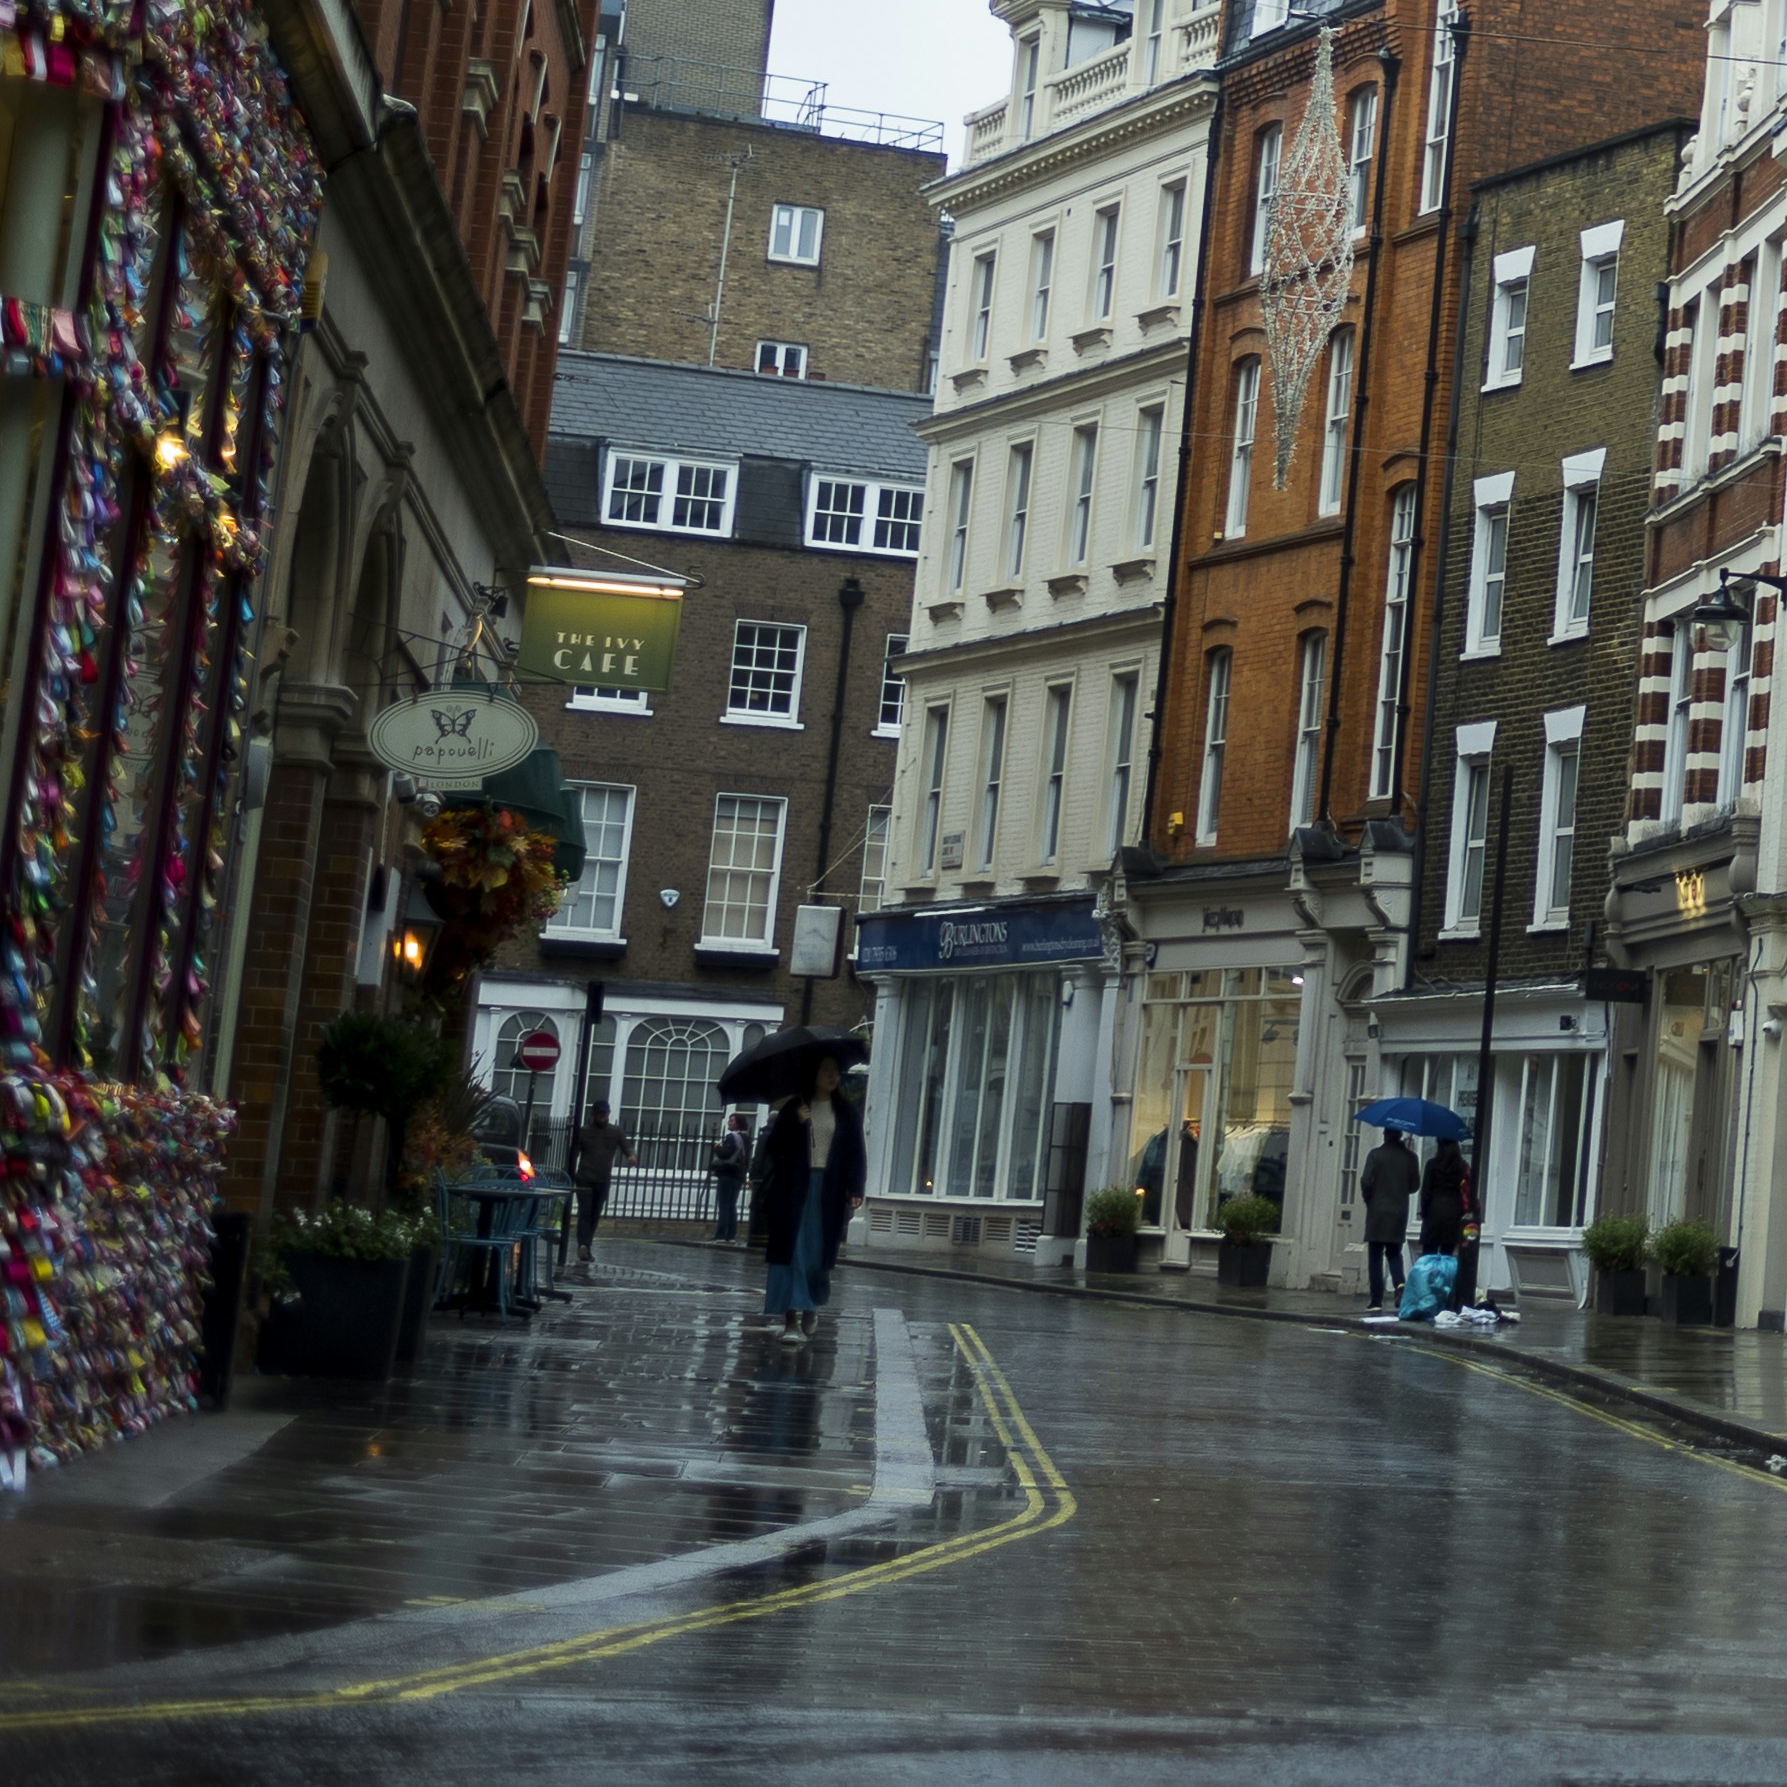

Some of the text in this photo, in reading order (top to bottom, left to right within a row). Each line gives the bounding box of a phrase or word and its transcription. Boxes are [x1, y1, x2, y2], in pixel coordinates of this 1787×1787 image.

[557, 632, 646, 650] THE IVY
[553, 648, 640, 675] CAFE
[412, 736, 495, 765] papouelli
[430, 780, 480, 789] LONDON
